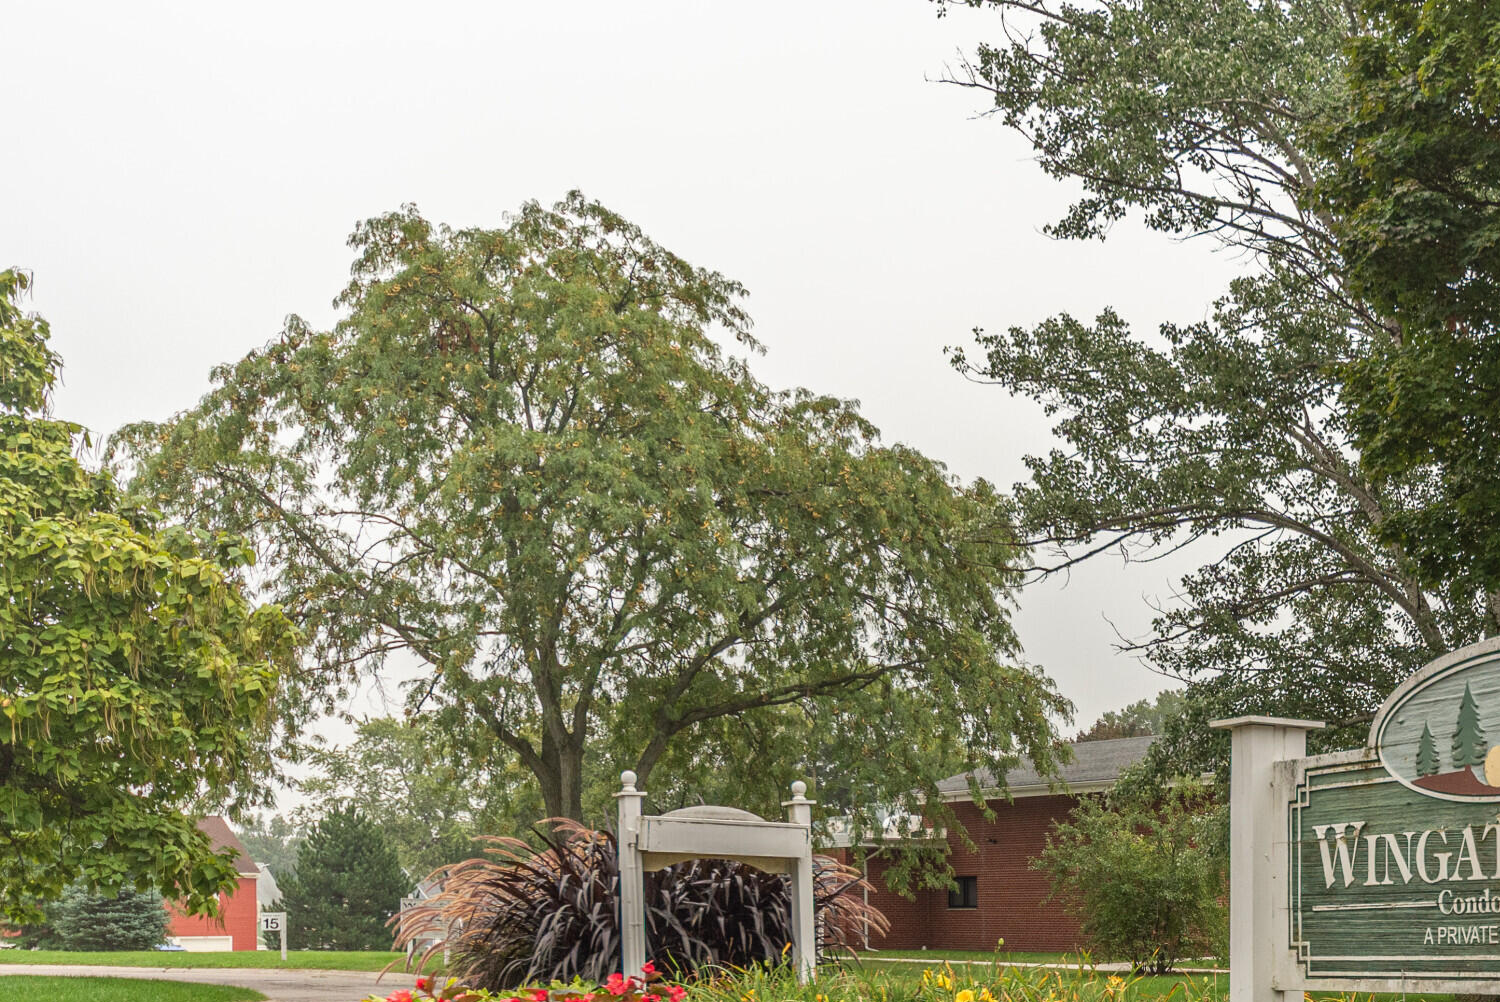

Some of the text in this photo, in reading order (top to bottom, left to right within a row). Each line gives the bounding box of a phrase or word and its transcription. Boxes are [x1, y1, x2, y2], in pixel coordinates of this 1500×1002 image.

[263, 918, 279, 929] 15
[1424, 927, 1434, 945] A
[1437, 925, 1500, 945] PRIVATE
